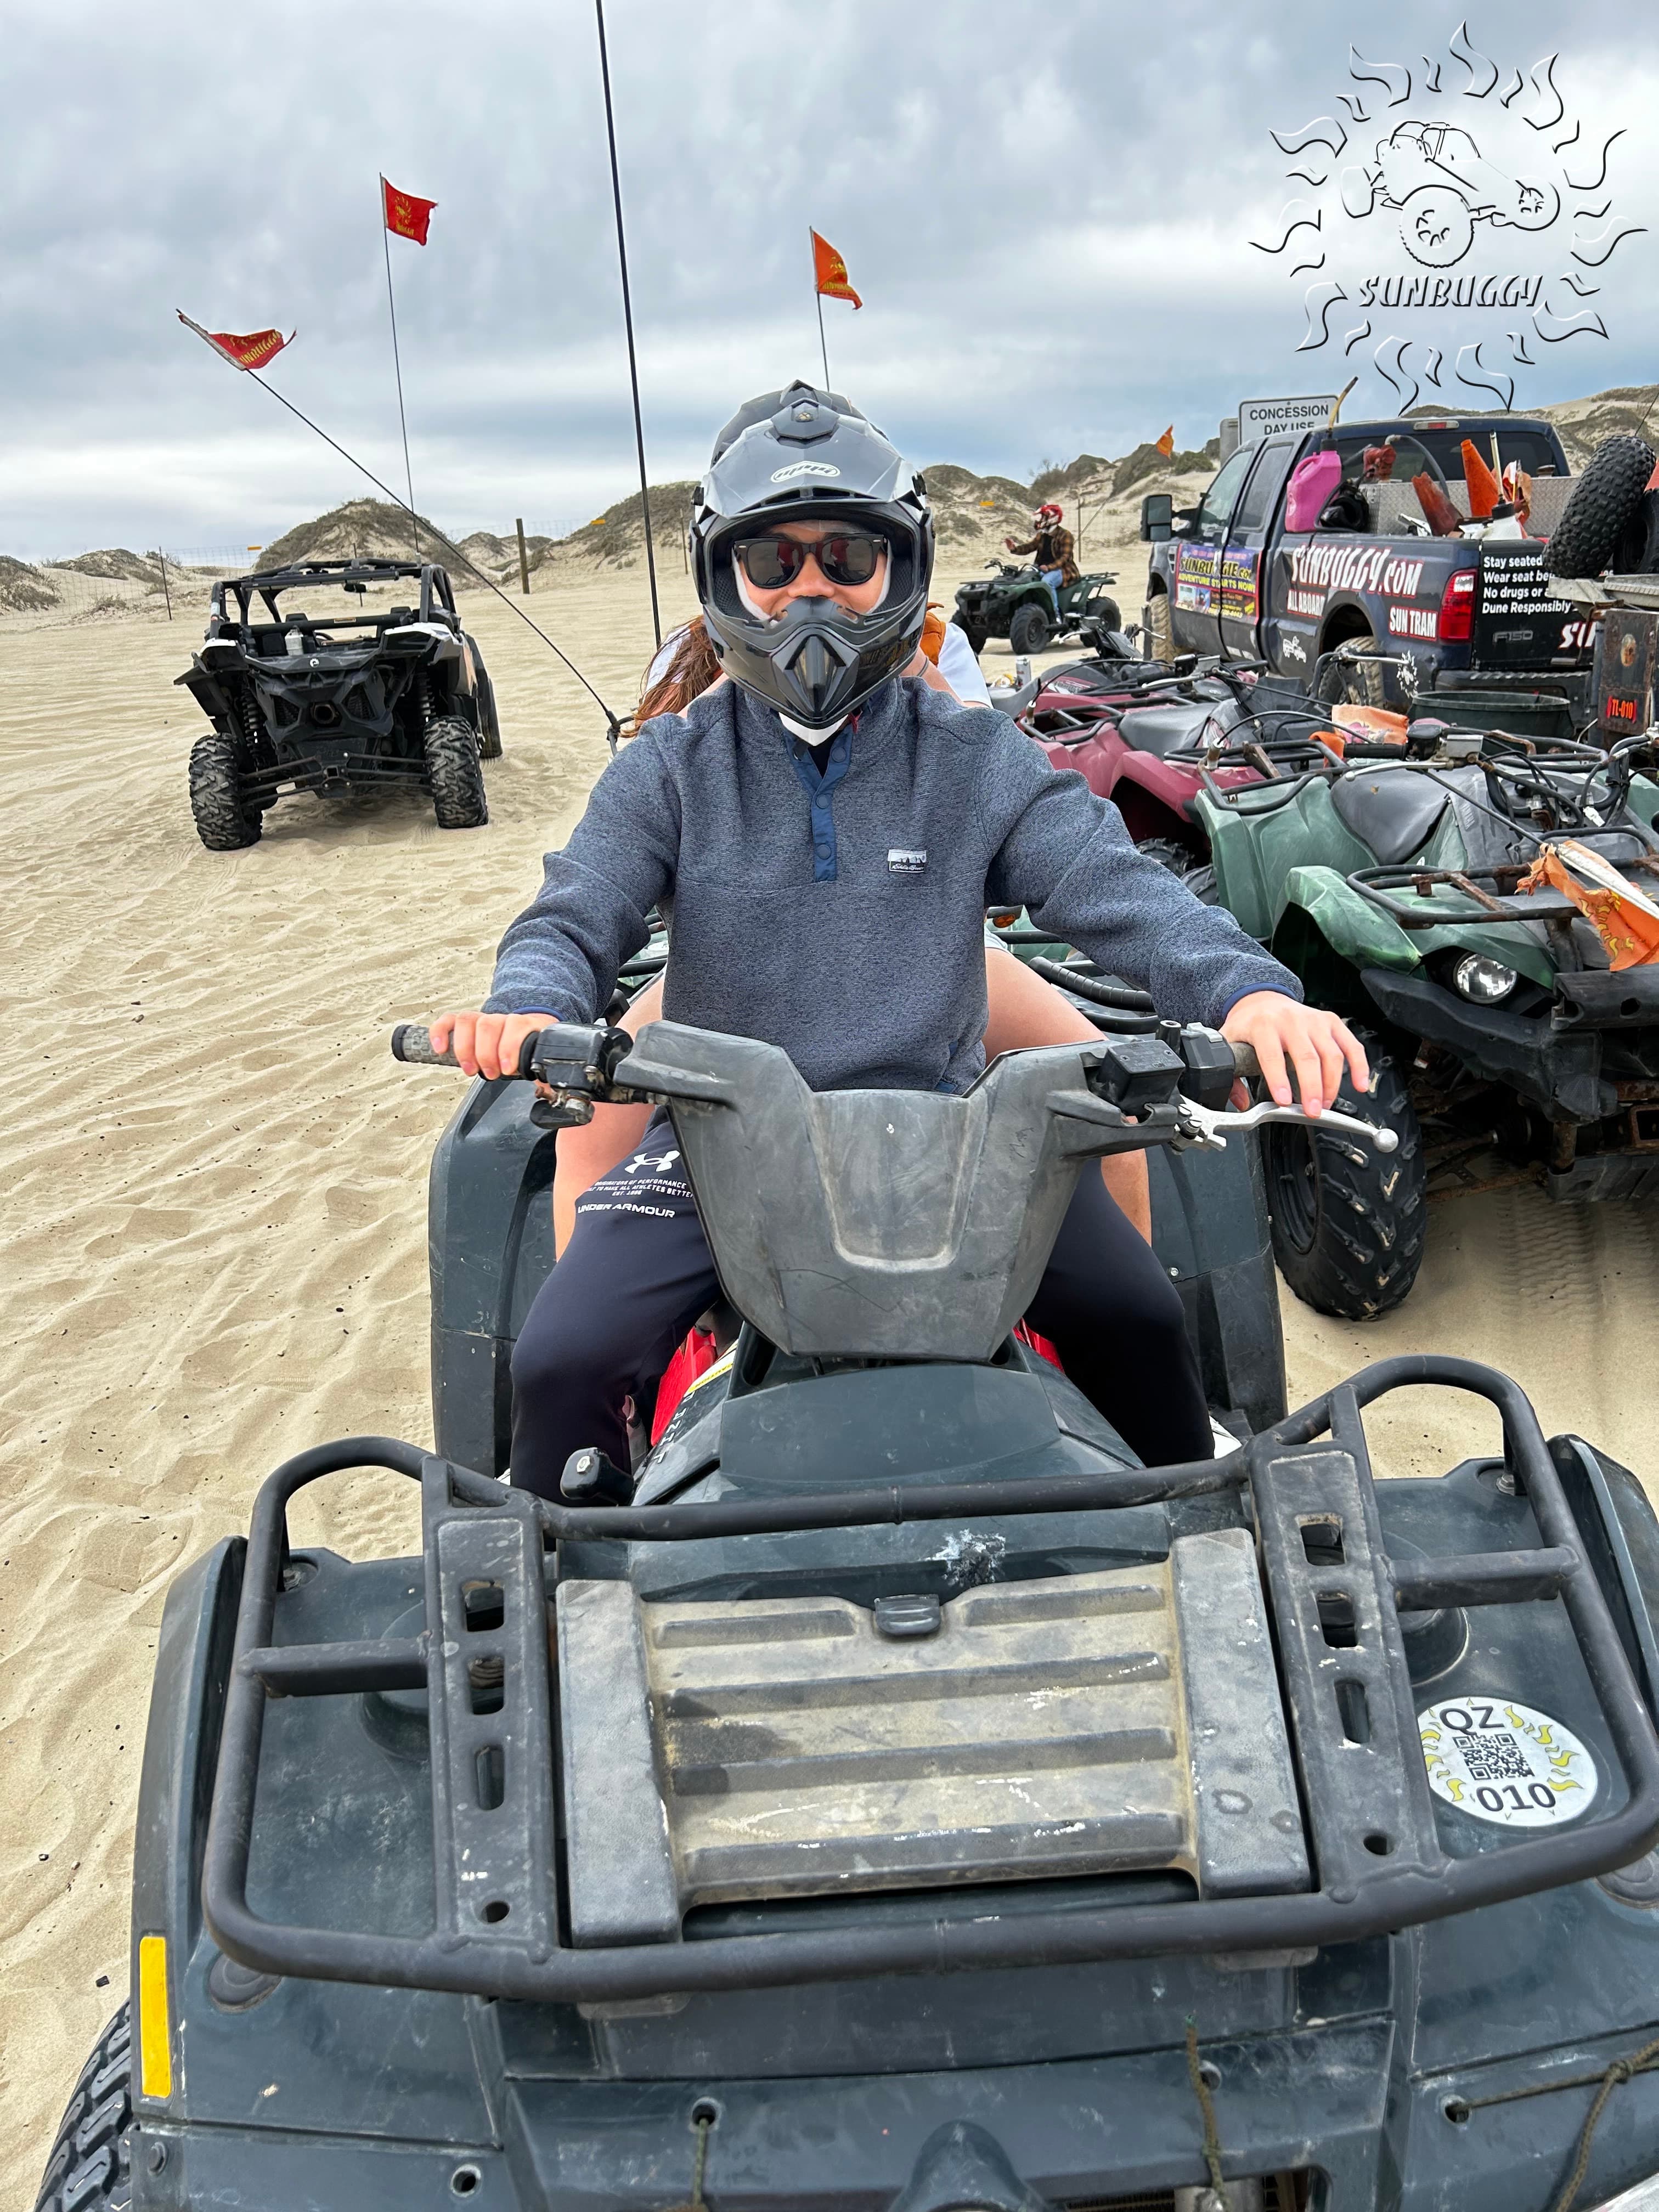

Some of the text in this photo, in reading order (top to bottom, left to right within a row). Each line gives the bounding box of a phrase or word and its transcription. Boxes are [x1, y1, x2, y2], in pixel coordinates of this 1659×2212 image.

[1250, 405, 1329, 420] CONCESSION
[1265, 422, 1288, 435] DAY
[1483, 554, 1543, 569] Stay seated
[1178, 573, 1210, 586] ADVENTURE
[1483, 571, 1510, 583] Wear
[1512, 570, 1534, 583] seat
[1483, 586, 1498, 599] No
[1500, 585, 1529, 600] drugs
[1531, 588, 1543, 597] or
[1287, 589, 1325, 617] ALL ABOARD
[1482, 600, 1572, 615] Dune Responsibly
[1389, 607, 1437, 638] SUN TRAM
[1493, 630, 1534, 643] F150
[631, 1184, 666, 1193] ATHLETES
[637, 1178, 687, 1189] PERFORMANCE
[577, 1203, 676, 1218] UNDER ARMOUR
[1439, 1705, 1505, 1736] QZ
[1476, 1782, 1556, 1812] 010
